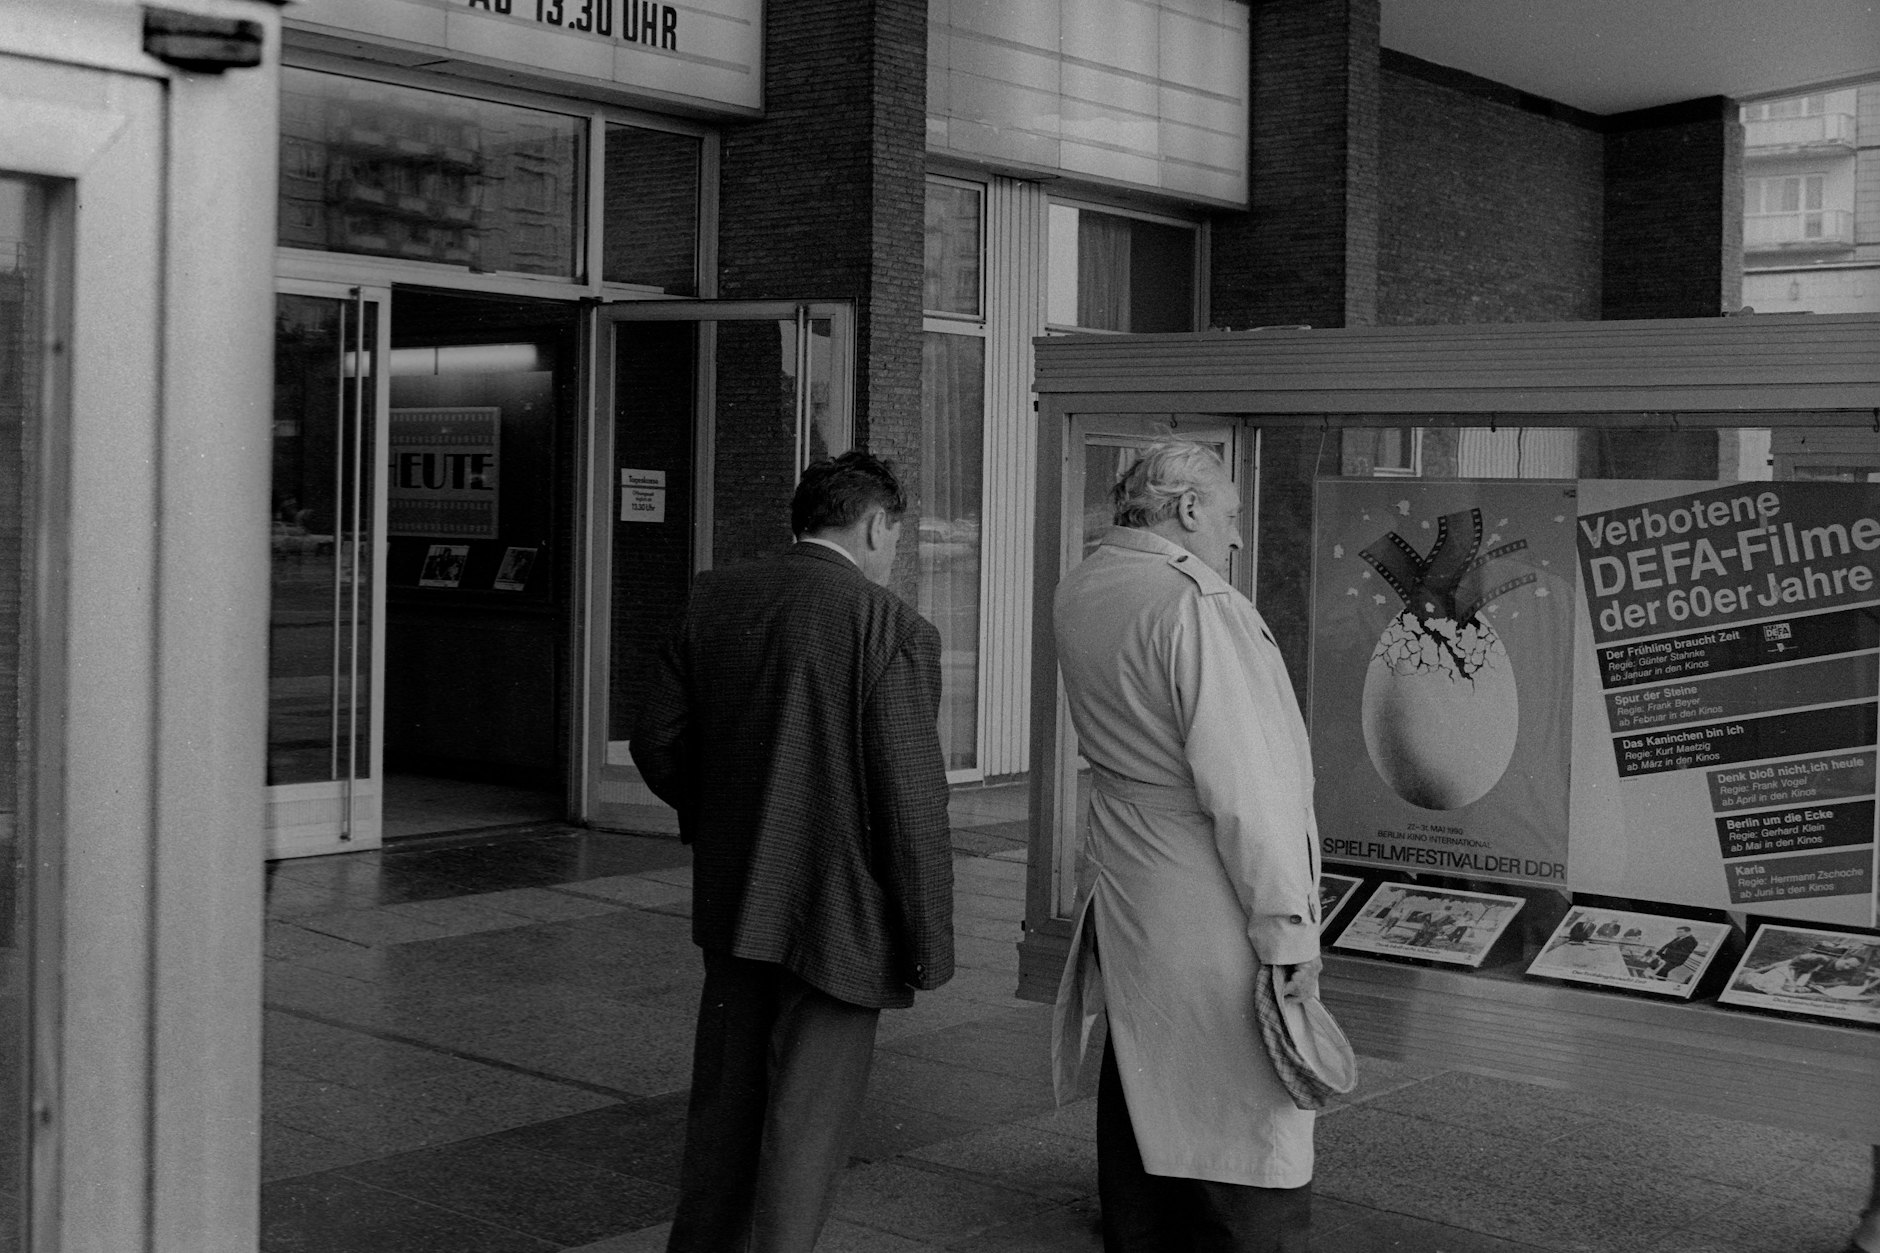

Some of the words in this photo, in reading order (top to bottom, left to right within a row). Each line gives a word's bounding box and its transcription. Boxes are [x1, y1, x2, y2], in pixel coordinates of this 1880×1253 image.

[623, 0, 676, 50] UHR
[1579, 491, 1780, 549] Verbotene
[1590, 518, 1880, 597] DEFA-Filme
[1599, 600, 1660, 632] der
[1667, 584, 1752, 620] 60er
[1758, 565, 1873, 607] Jahre
[1766, 628, 1789, 637] DEFA
[1606, 650, 1624, 660] Der
[1628, 642, 1672, 657] Frühling
[1674, 636, 1716, 649] braucht
[1719, 631, 1740, 642] Zeit
[1609, 660, 1636, 671] Regie:
[1639, 655, 1667, 666] Günter
[1670, 649, 1705, 660] Stahnke
[1610, 673, 1621, 682] ab
[1623, 669, 1652, 680] Januar
[1655, 666, 1662, 674] in
[1665, 663, 1682, 673] den
[1685, 660, 1709, 670] Kinos
[1615, 695, 1639, 706] Spur
[1644, 690, 1661, 700] der
[1664, 685, 1697, 697] Steine
[1617, 706, 1645, 716] Regie:
[1648, 701, 1671, 711] Frank
[1675, 697, 1700, 710] Beyer
[1619, 717, 1630, 726] ab
[1633, 713, 1666, 724] Februar
[1669, 711, 1677, 719] in
[1680, 708, 1696, 718] den
[1699, 705, 1723, 715] Kinos
[1623, 740, 1643, 749] Das
[1646, 731, 1703, 746] Kaninchen
[1706, 728, 1724, 738] bin
[1727, 725, 1744, 735] ich
[1625, 750, 1652, 761] Regie:
[1656, 746, 1674, 756] Kurt
[1676, 742, 1711, 754] Maetzig
[1627, 762, 1638, 771] ab
[1641, 758, 1662, 769] März
[1665, 757, 1673, 765] in
[1676, 754, 1693, 764] den
[1696, 751, 1720, 761] Kinos
[1718, 774, 1746, 783] Denk
[1750, 768, 1774, 780] bloß
[1811, 762, 1828, 772] ich
[1833, 758, 1864, 769] heule
[1720, 786, 1749, 795] Regie:
[1753, 782, 1778, 791] Frank
[1781, 778, 1807, 789] Vogel
[1722, 798, 1733, 806] ab
[1736, 795, 1756, 805] April
[1770, 792, 1788, 800] den
[1791, 788, 1816, 797] Kinos
[1727, 818, 1759, 829] Berlin
[1763, 817, 1781, 825] um
[1785, 814, 1802, 823] die
[1805, 810, 1833, 820] Ecke
[1378, 830, 1405, 840] BERLIN
[1407, 832, 1427, 842] KINO
[1429, 836, 1491, 848] INTERNATIONAL
[1729, 832, 1758, 841] Regie:
[1761, 826, 1798, 837] Gerhard
[1802, 824, 1825, 833] Klein
[1731, 844, 1742, 852] ab
[1746, 842, 1761, 850] Mai
[1776, 838, 1794, 846] den
[1797, 836, 1822, 844] Kinos
[1323, 838, 1480, 870] SPIELFILMFESTIVAL
[1486, 856, 1521, 874] DER
[1525, 861, 1564, 879] DDR
[1735, 866, 1765, 875] Karla
[1738, 878, 1767, 887] Regie:
[1770, 873, 1816, 884] Herrmann
[1818, 868, 1864, 879] Zschoche
[1755, 888, 1773, 896] Juni
[1809, 883, 1834, 891] Kinos
